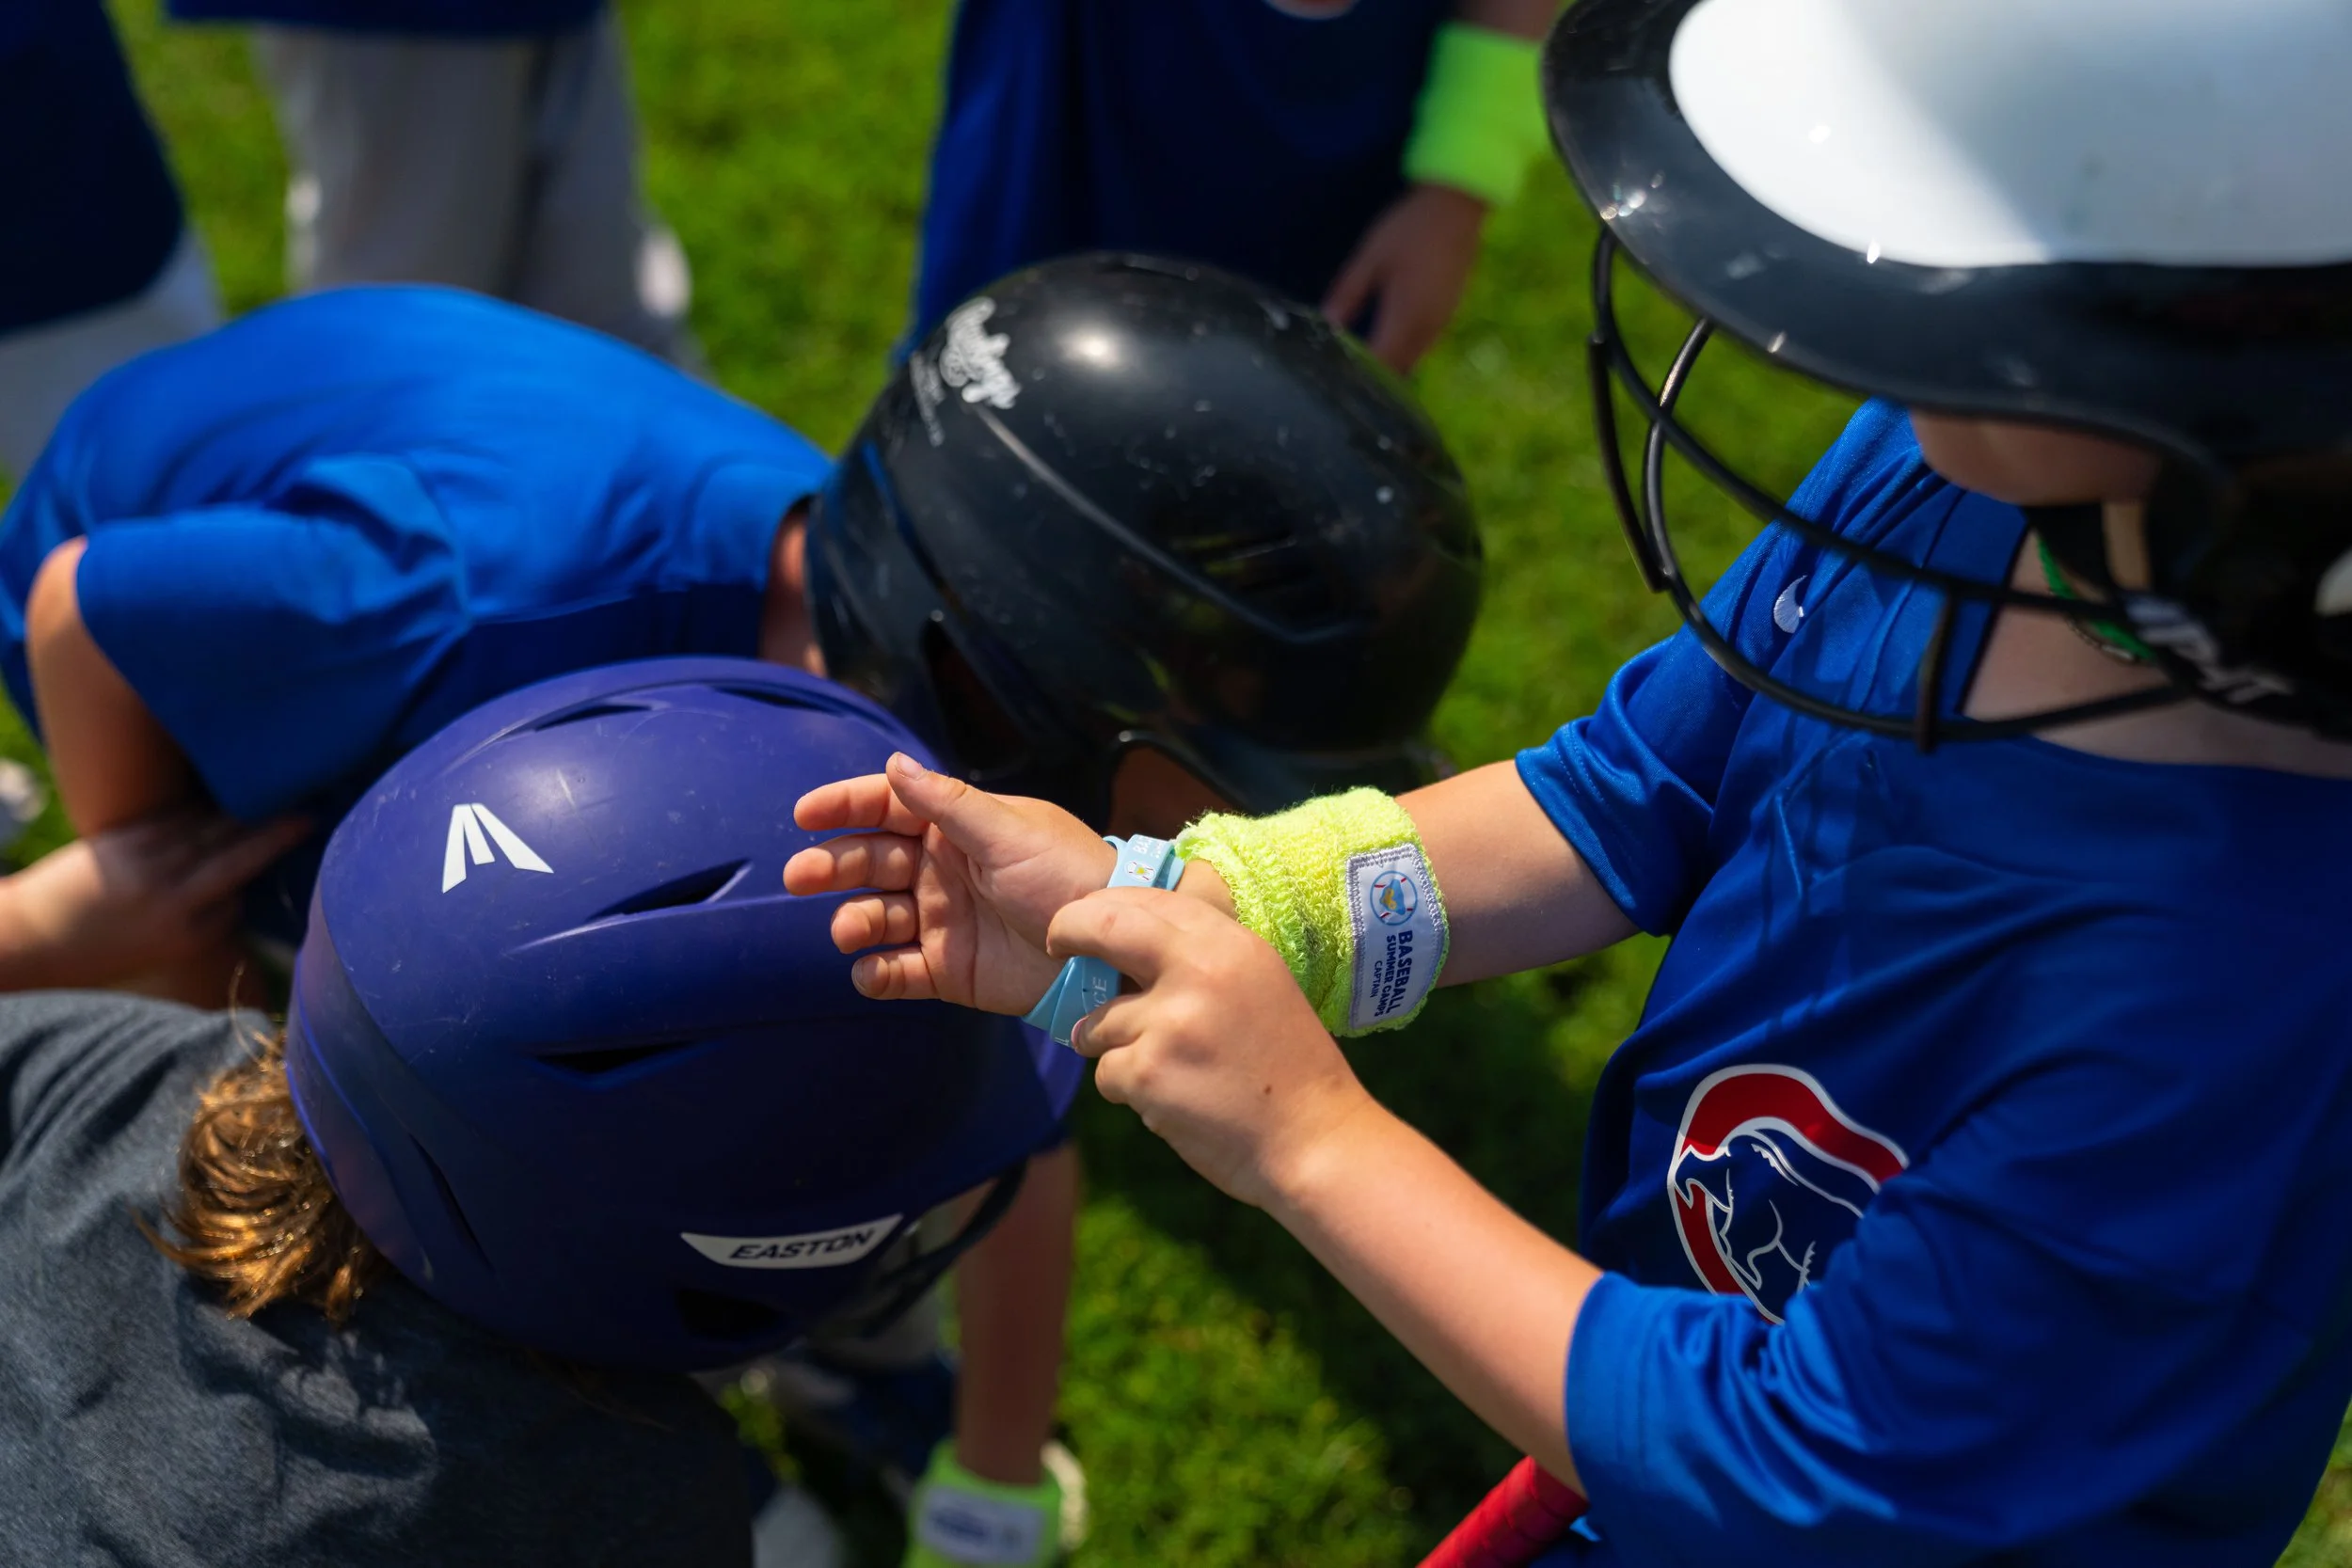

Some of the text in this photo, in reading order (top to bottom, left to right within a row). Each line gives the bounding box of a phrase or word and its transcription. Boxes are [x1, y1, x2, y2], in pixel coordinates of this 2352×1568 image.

[1371, 961, 1383, 997] CAPTAIN
[1375, 935, 1396, 1017] SUMMER CAMPS
[1387, 929, 1413, 1014] BASEBALL
[728, 1227, 876, 1259] EASTON
